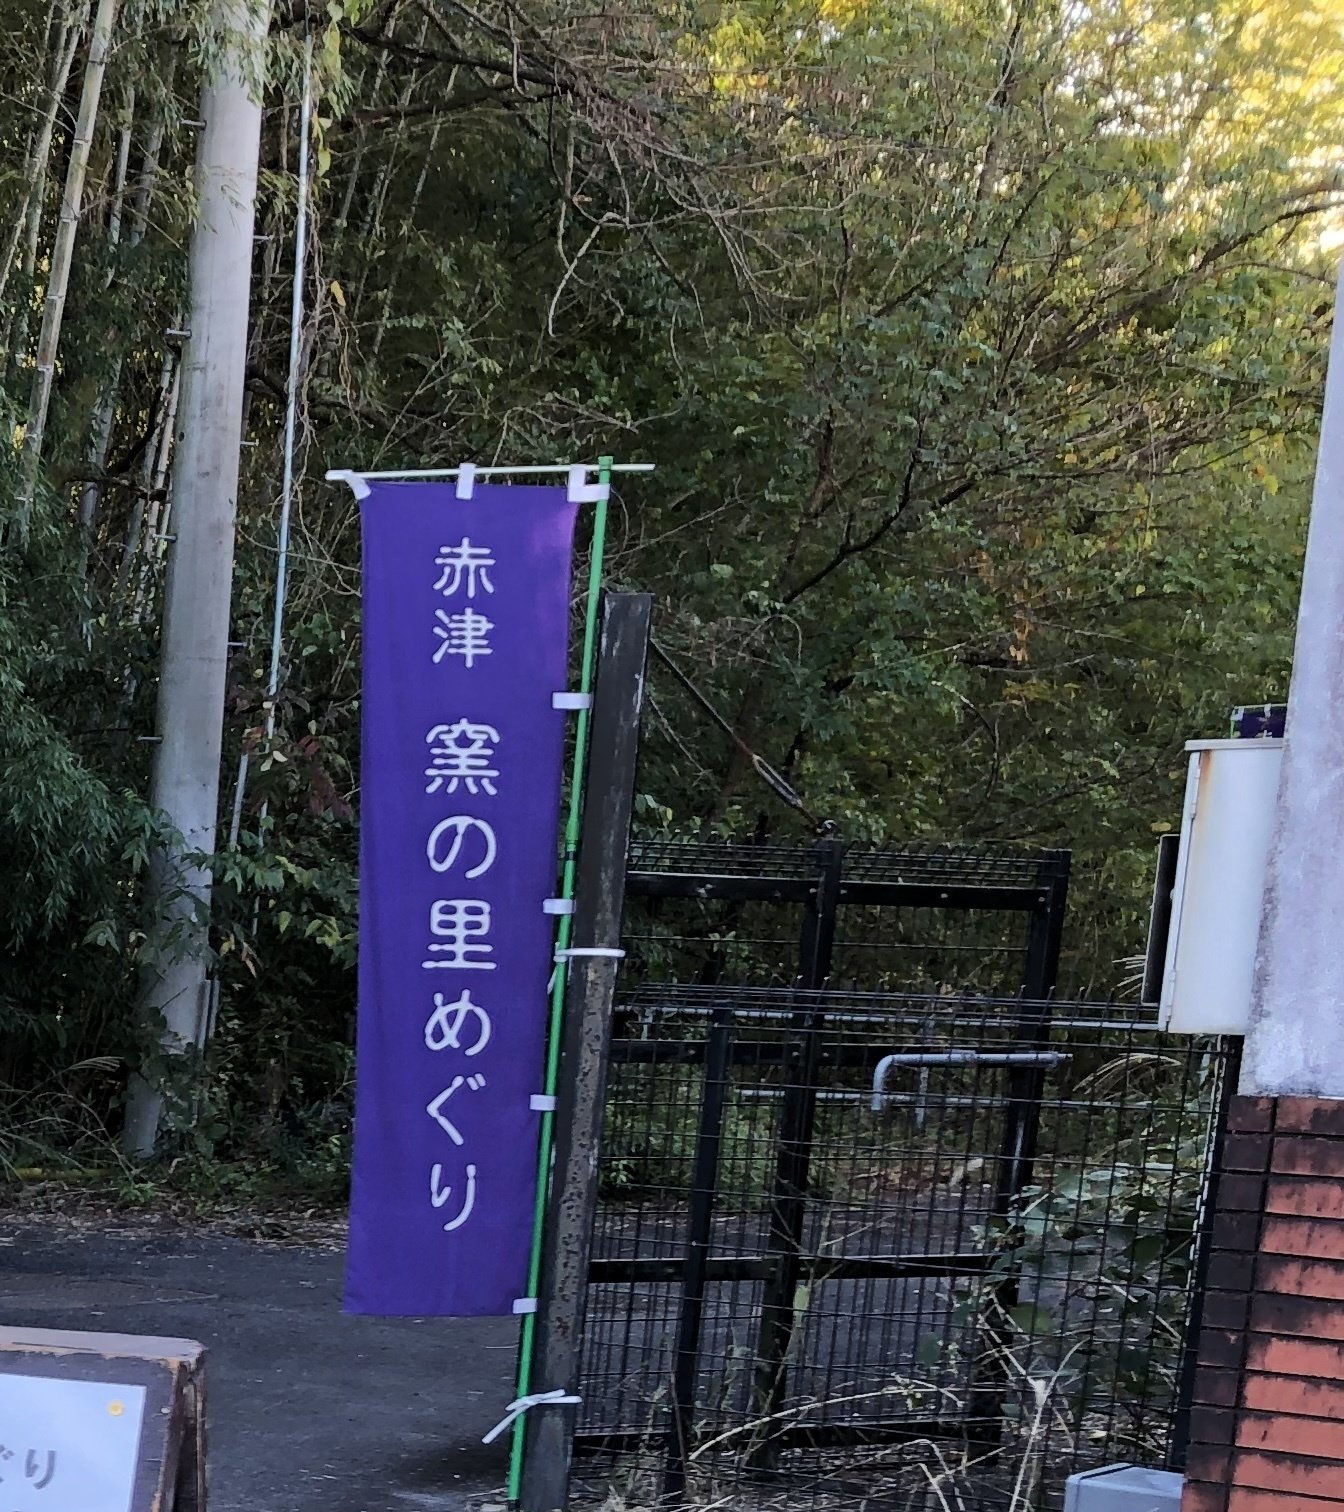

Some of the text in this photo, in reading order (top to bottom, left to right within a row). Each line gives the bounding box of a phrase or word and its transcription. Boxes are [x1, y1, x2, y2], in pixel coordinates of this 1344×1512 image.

[421, 536, 501, 1231] 赤津 窯の里めぐり
